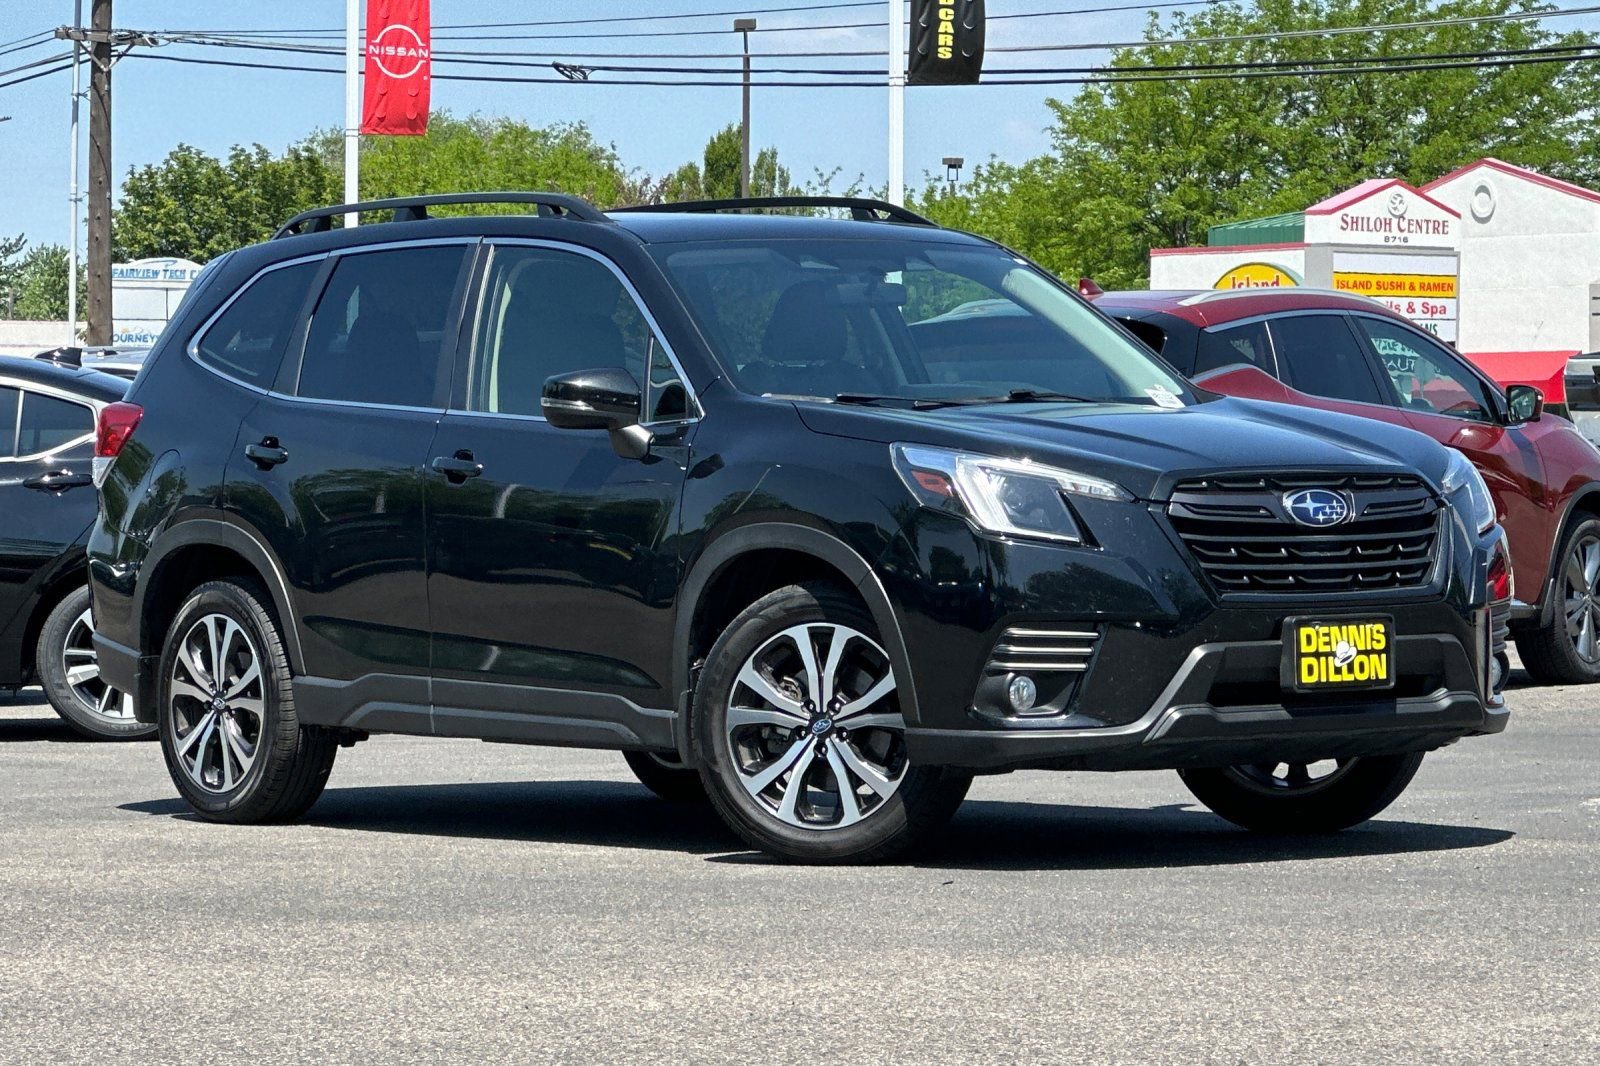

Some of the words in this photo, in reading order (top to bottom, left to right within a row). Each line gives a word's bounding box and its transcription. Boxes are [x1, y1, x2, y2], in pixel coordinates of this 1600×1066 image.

[938, 8, 954, 59] CARS
[369, 45, 428, 58] NISSAN
[1340, 213, 1392, 232] SHILOH
[1397, 216, 1449, 234] CENTRE
[112, 268, 160, 278] FAIRVIEW
[163, 269, 186, 280] TECH
[1336, 280, 1372, 290] ISLAND
[1376, 281, 1406, 291] SUSHI
[1408, 282, 1416, 292] &
[1419, 282, 1454, 292] RAMEN
[1406, 302, 1416, 314] &
[1422, 302, 1446, 317] Spa
[112, 334, 160, 342] OURNEY
[1300, 624, 1386, 652] DENNIS
[1301, 654, 1386, 683] DILLON
